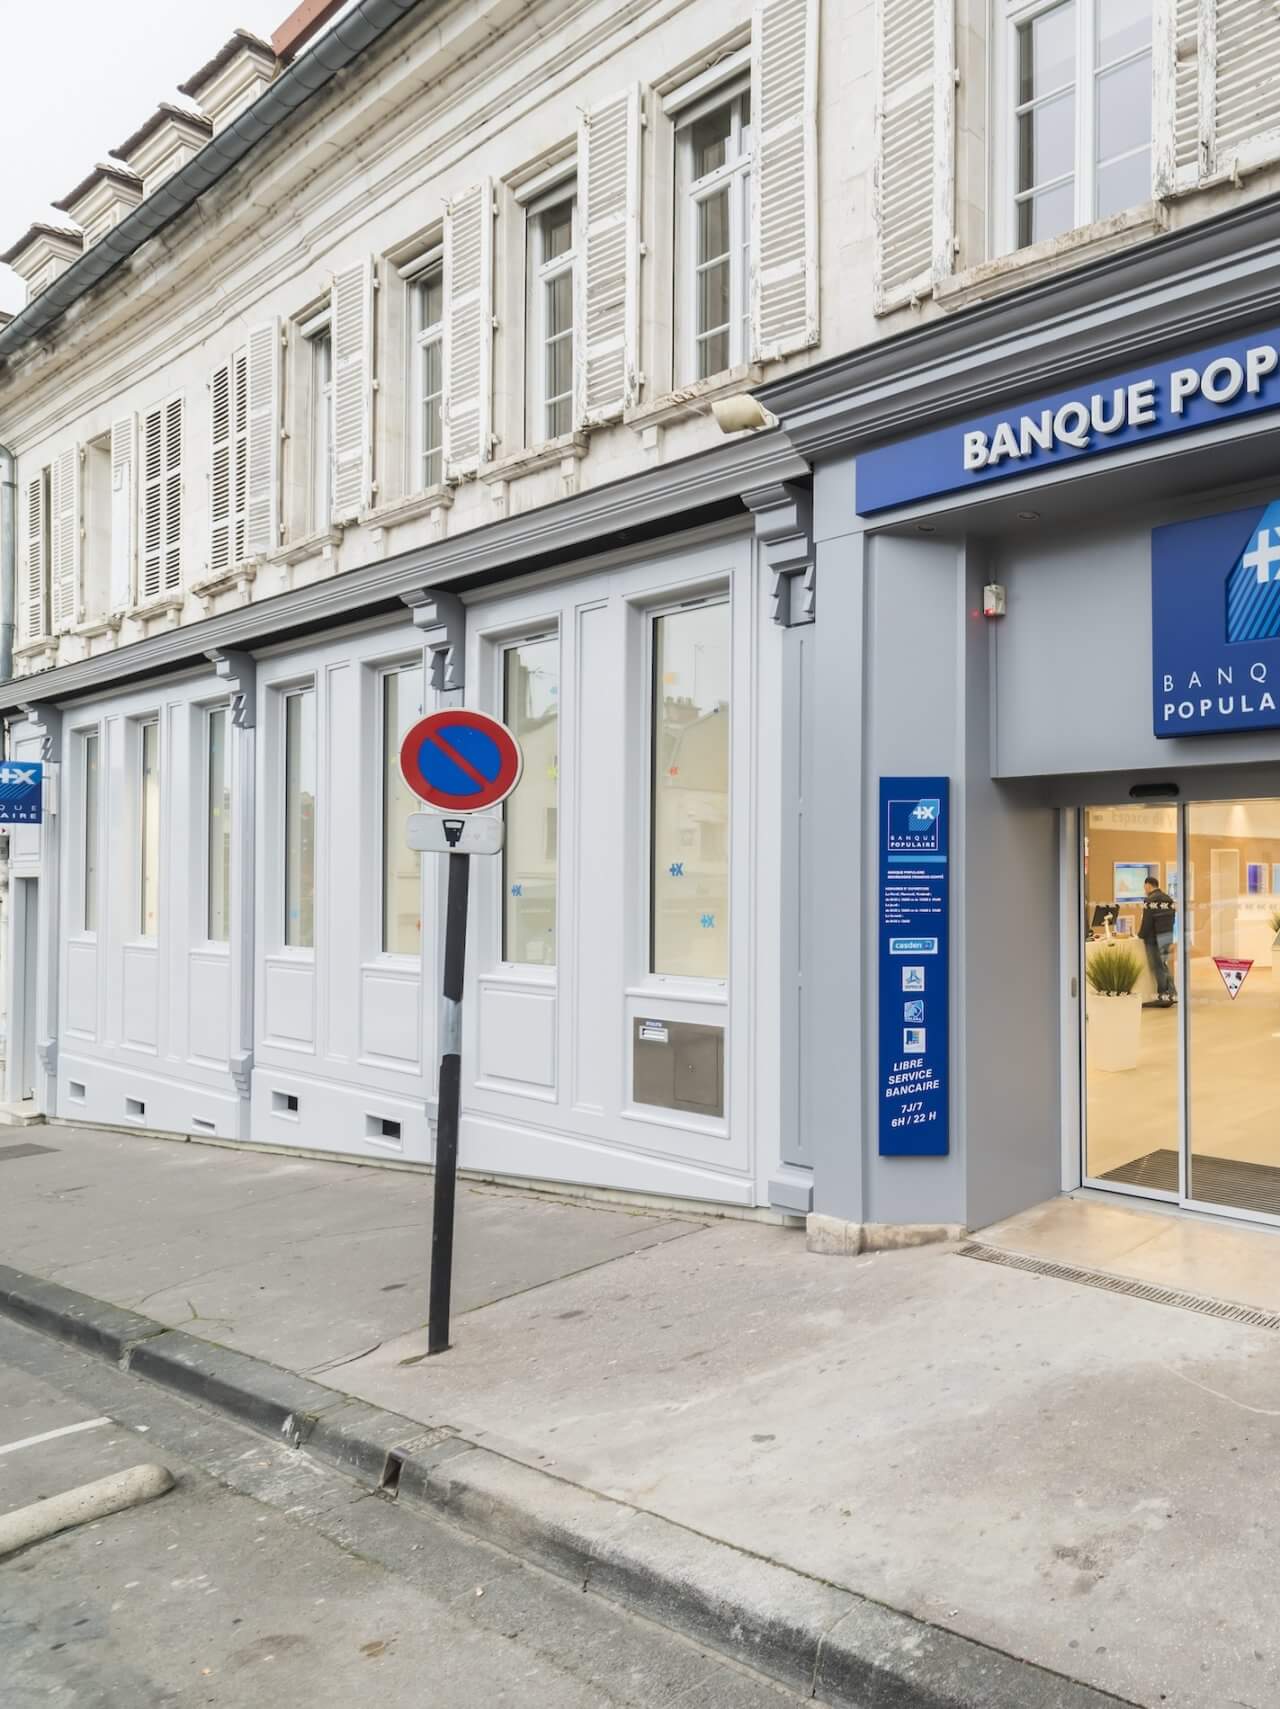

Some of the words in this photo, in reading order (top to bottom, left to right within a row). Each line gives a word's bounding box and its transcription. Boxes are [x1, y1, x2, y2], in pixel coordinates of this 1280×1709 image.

[962, 379, 1156, 470] BANQUE
[895, 941, 922, 950] casden
[893, 1058, 924, 1072] LIBRE
[888, 1069, 932, 1085] SERVICE
[885, 1079, 940, 1097] BANCAIRE
[901, 1102, 923, 1113] 7J/7
[891, 1117, 905, 1128] 6H
[913, 1114, 926, 1124] 22
[928, 1111, 937, 1121] H
